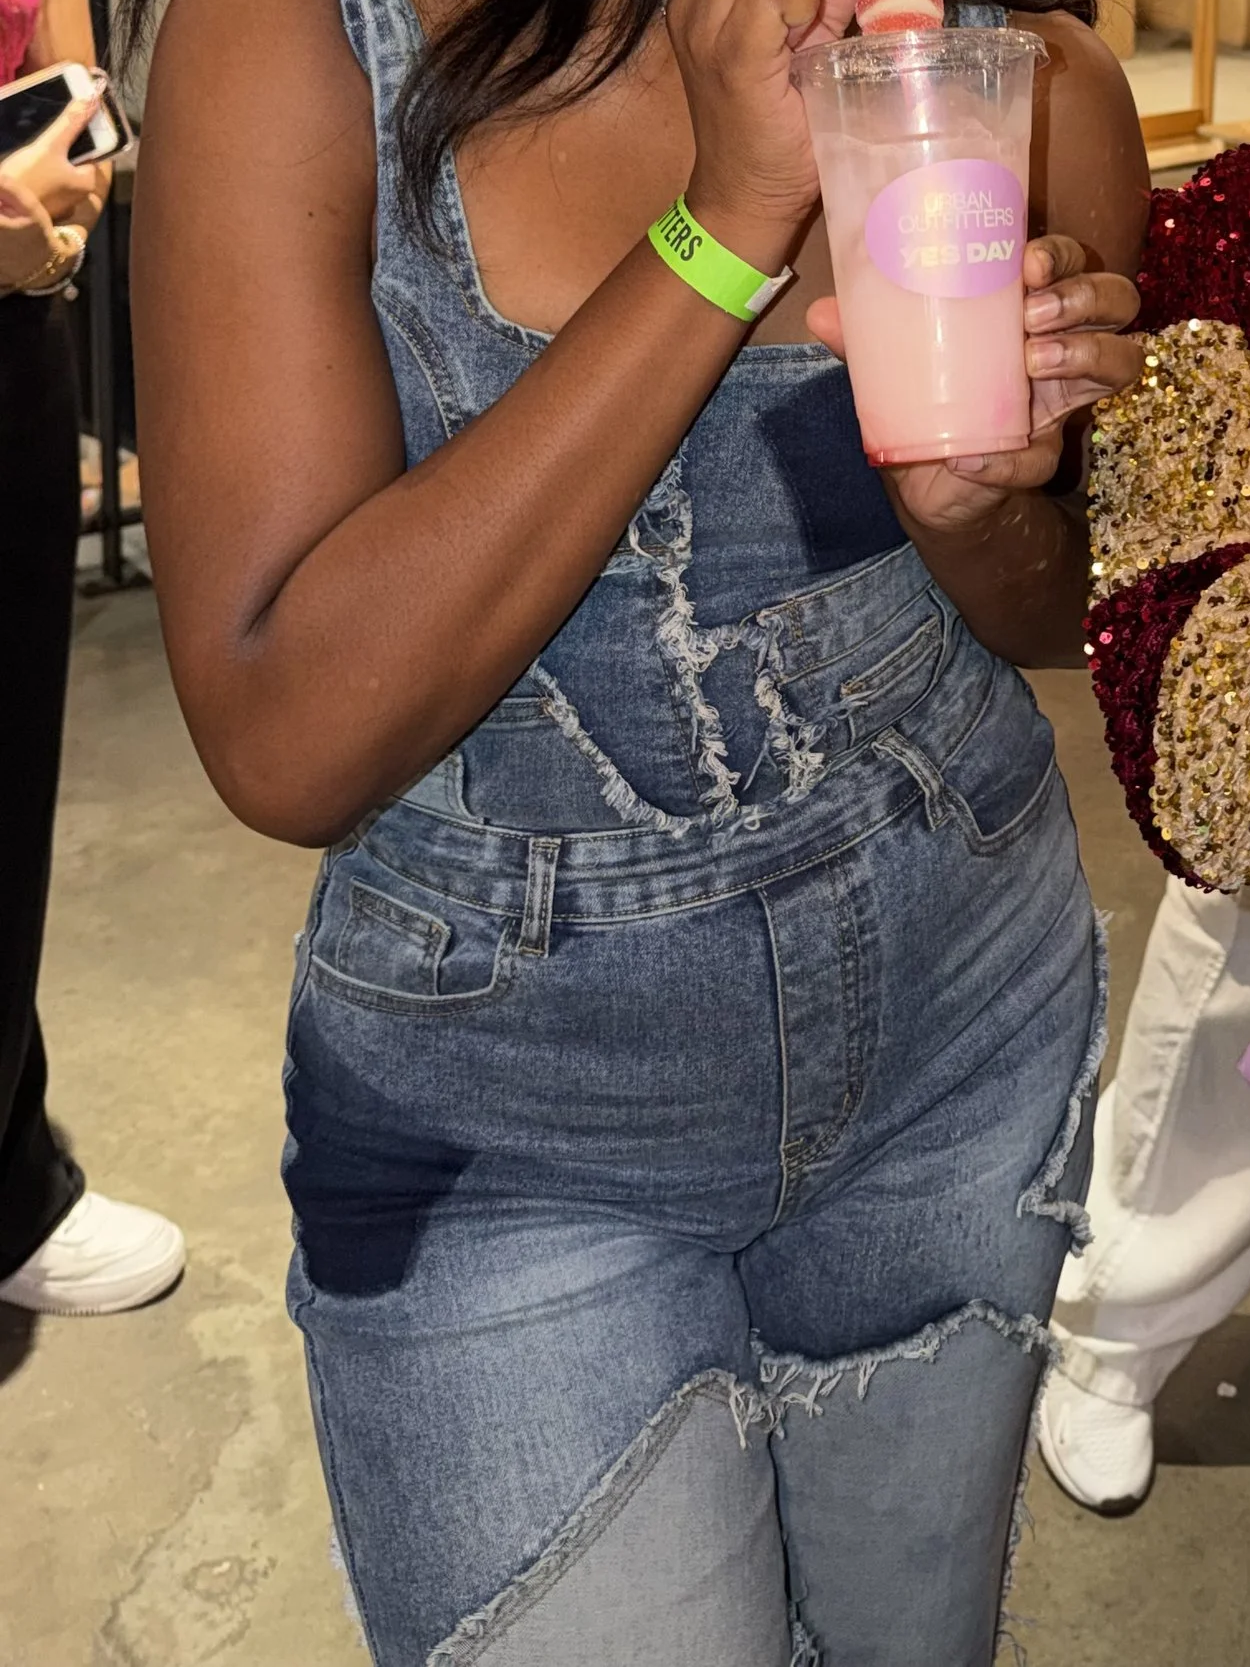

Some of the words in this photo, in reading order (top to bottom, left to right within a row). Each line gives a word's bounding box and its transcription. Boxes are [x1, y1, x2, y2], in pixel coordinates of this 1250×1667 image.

[924, 190, 992, 214] URBAN
[898, 207, 1015, 234] OUTFITTERS
[899, 243, 961, 269] YES
[966, 239, 1015, 264] DAY
